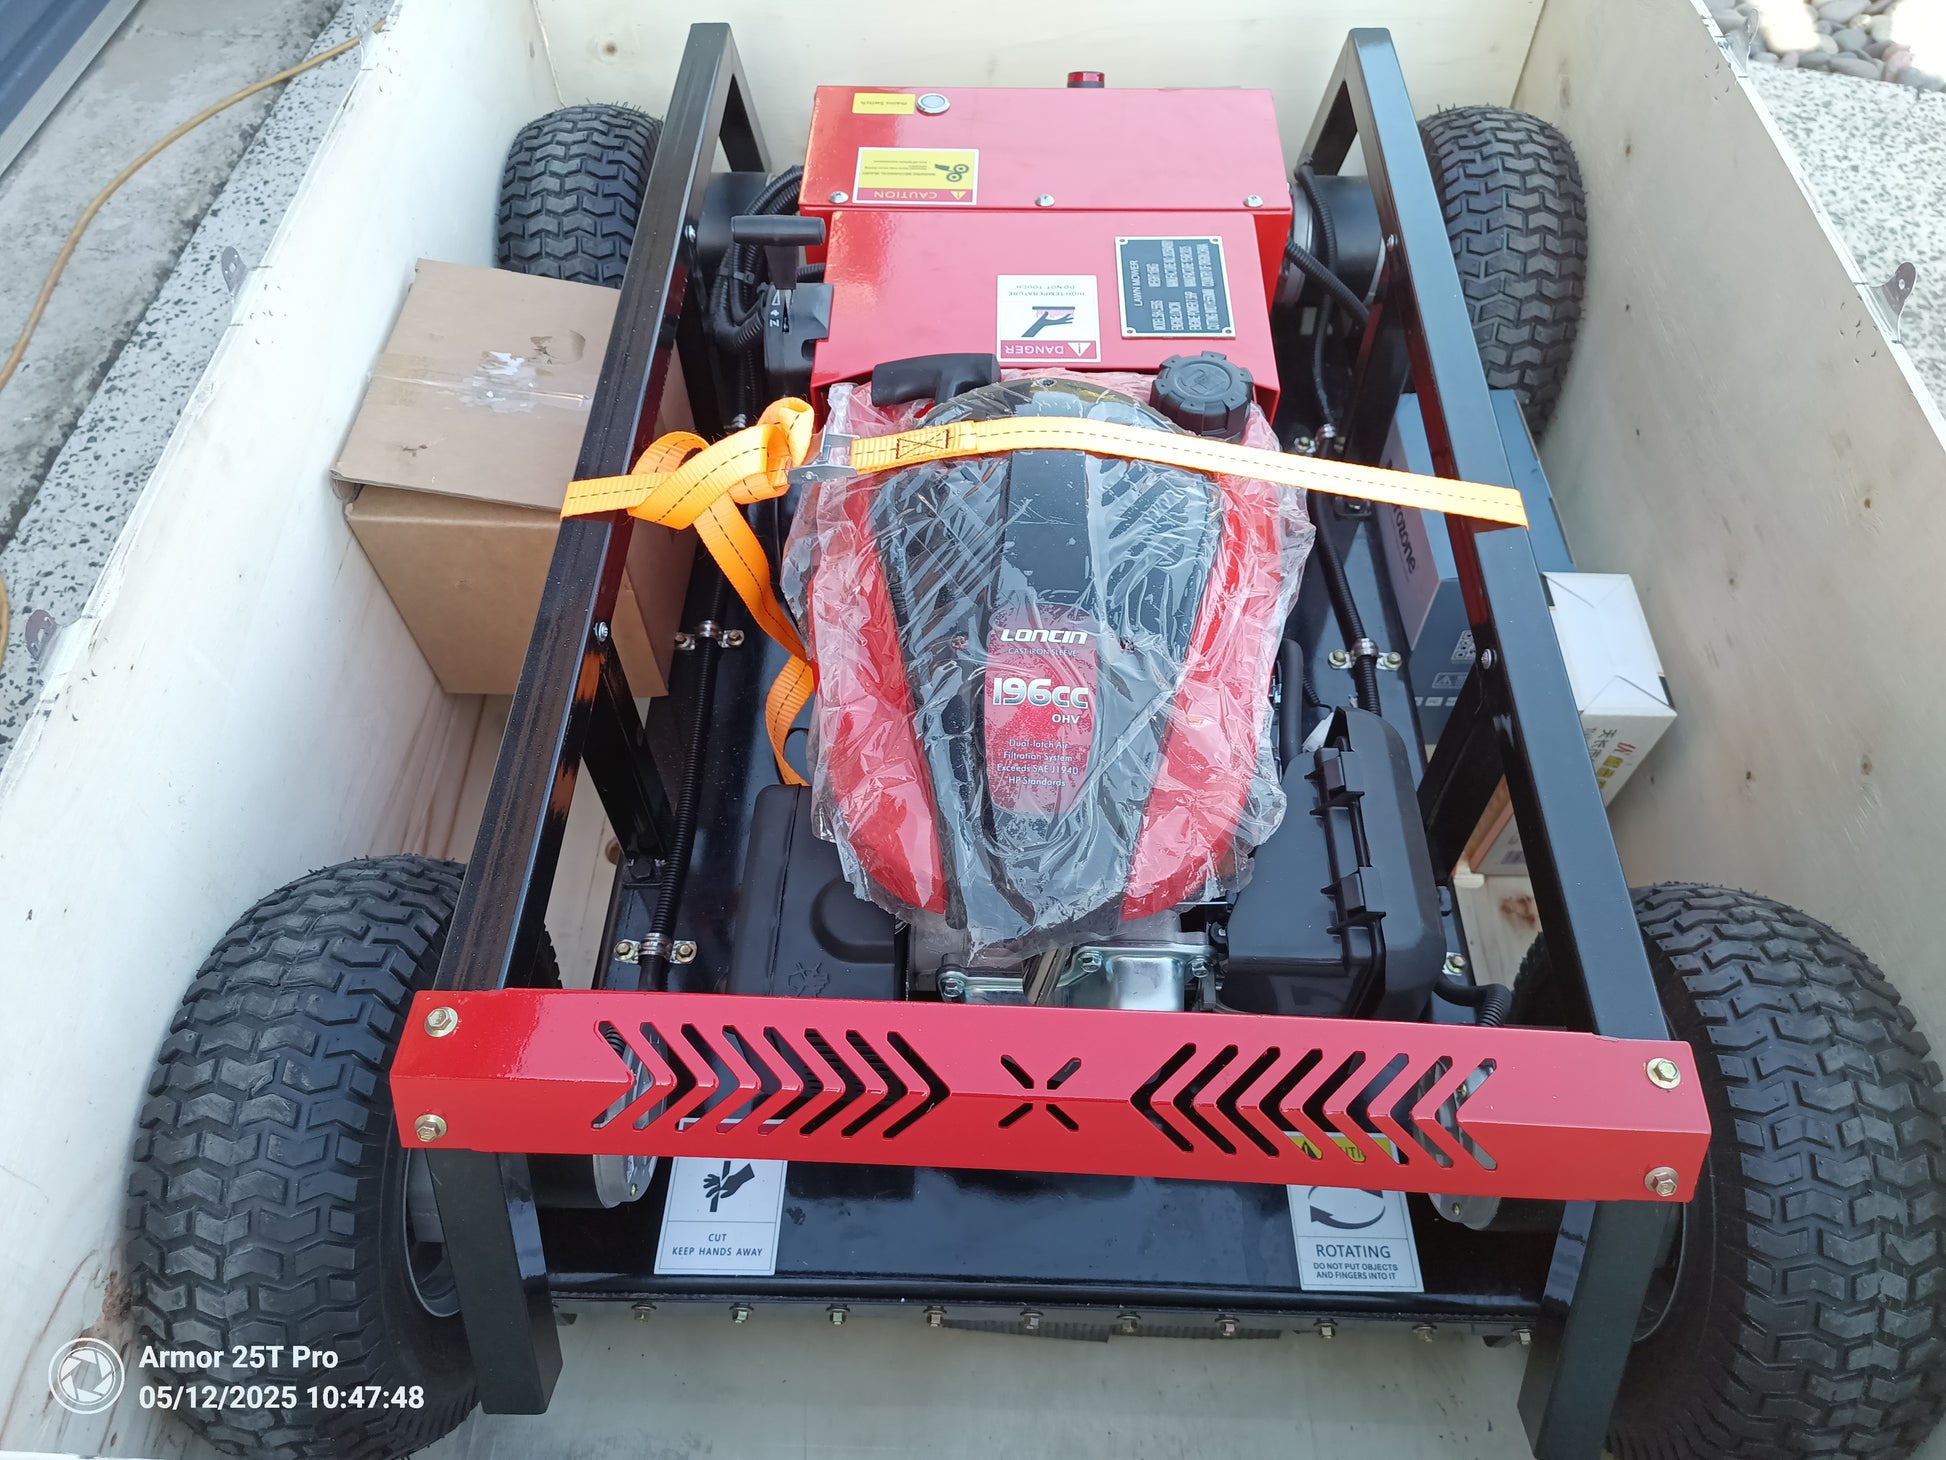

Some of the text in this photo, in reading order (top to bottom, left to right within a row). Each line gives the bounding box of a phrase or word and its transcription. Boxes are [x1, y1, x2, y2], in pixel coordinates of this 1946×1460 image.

[874, 190, 938, 199] CAUTION
[1129, 260, 1143, 306] LAWN MOWER
[1005, 345, 1064, 354] DANGER
[1029, 648, 1050, 656] IRON
[992, 677, 1089, 709] 196cc
[1052, 713, 1081, 724] OHV
[1009, 738, 1069, 749] Dual-latch Air
[1003, 751, 1073, 763] Filtration System
[996, 763, 1079, 775] Exceeds SAE J1940
[1008, 776, 1066, 787] HP Standards
[708, 1233, 727, 1242] CUT
[672, 1246, 763, 1256] KEEP HANDS AWAY
[1315, 1244, 1391, 1259] ROTATING
[1313, 1262, 1326, 1270] DO
[1326, 1262, 1343, 1270] NOT
[1361, 1263, 1399, 1271] OBJECTS
[1316, 1271, 1396, 1280] AND FINGERS INTO IT
